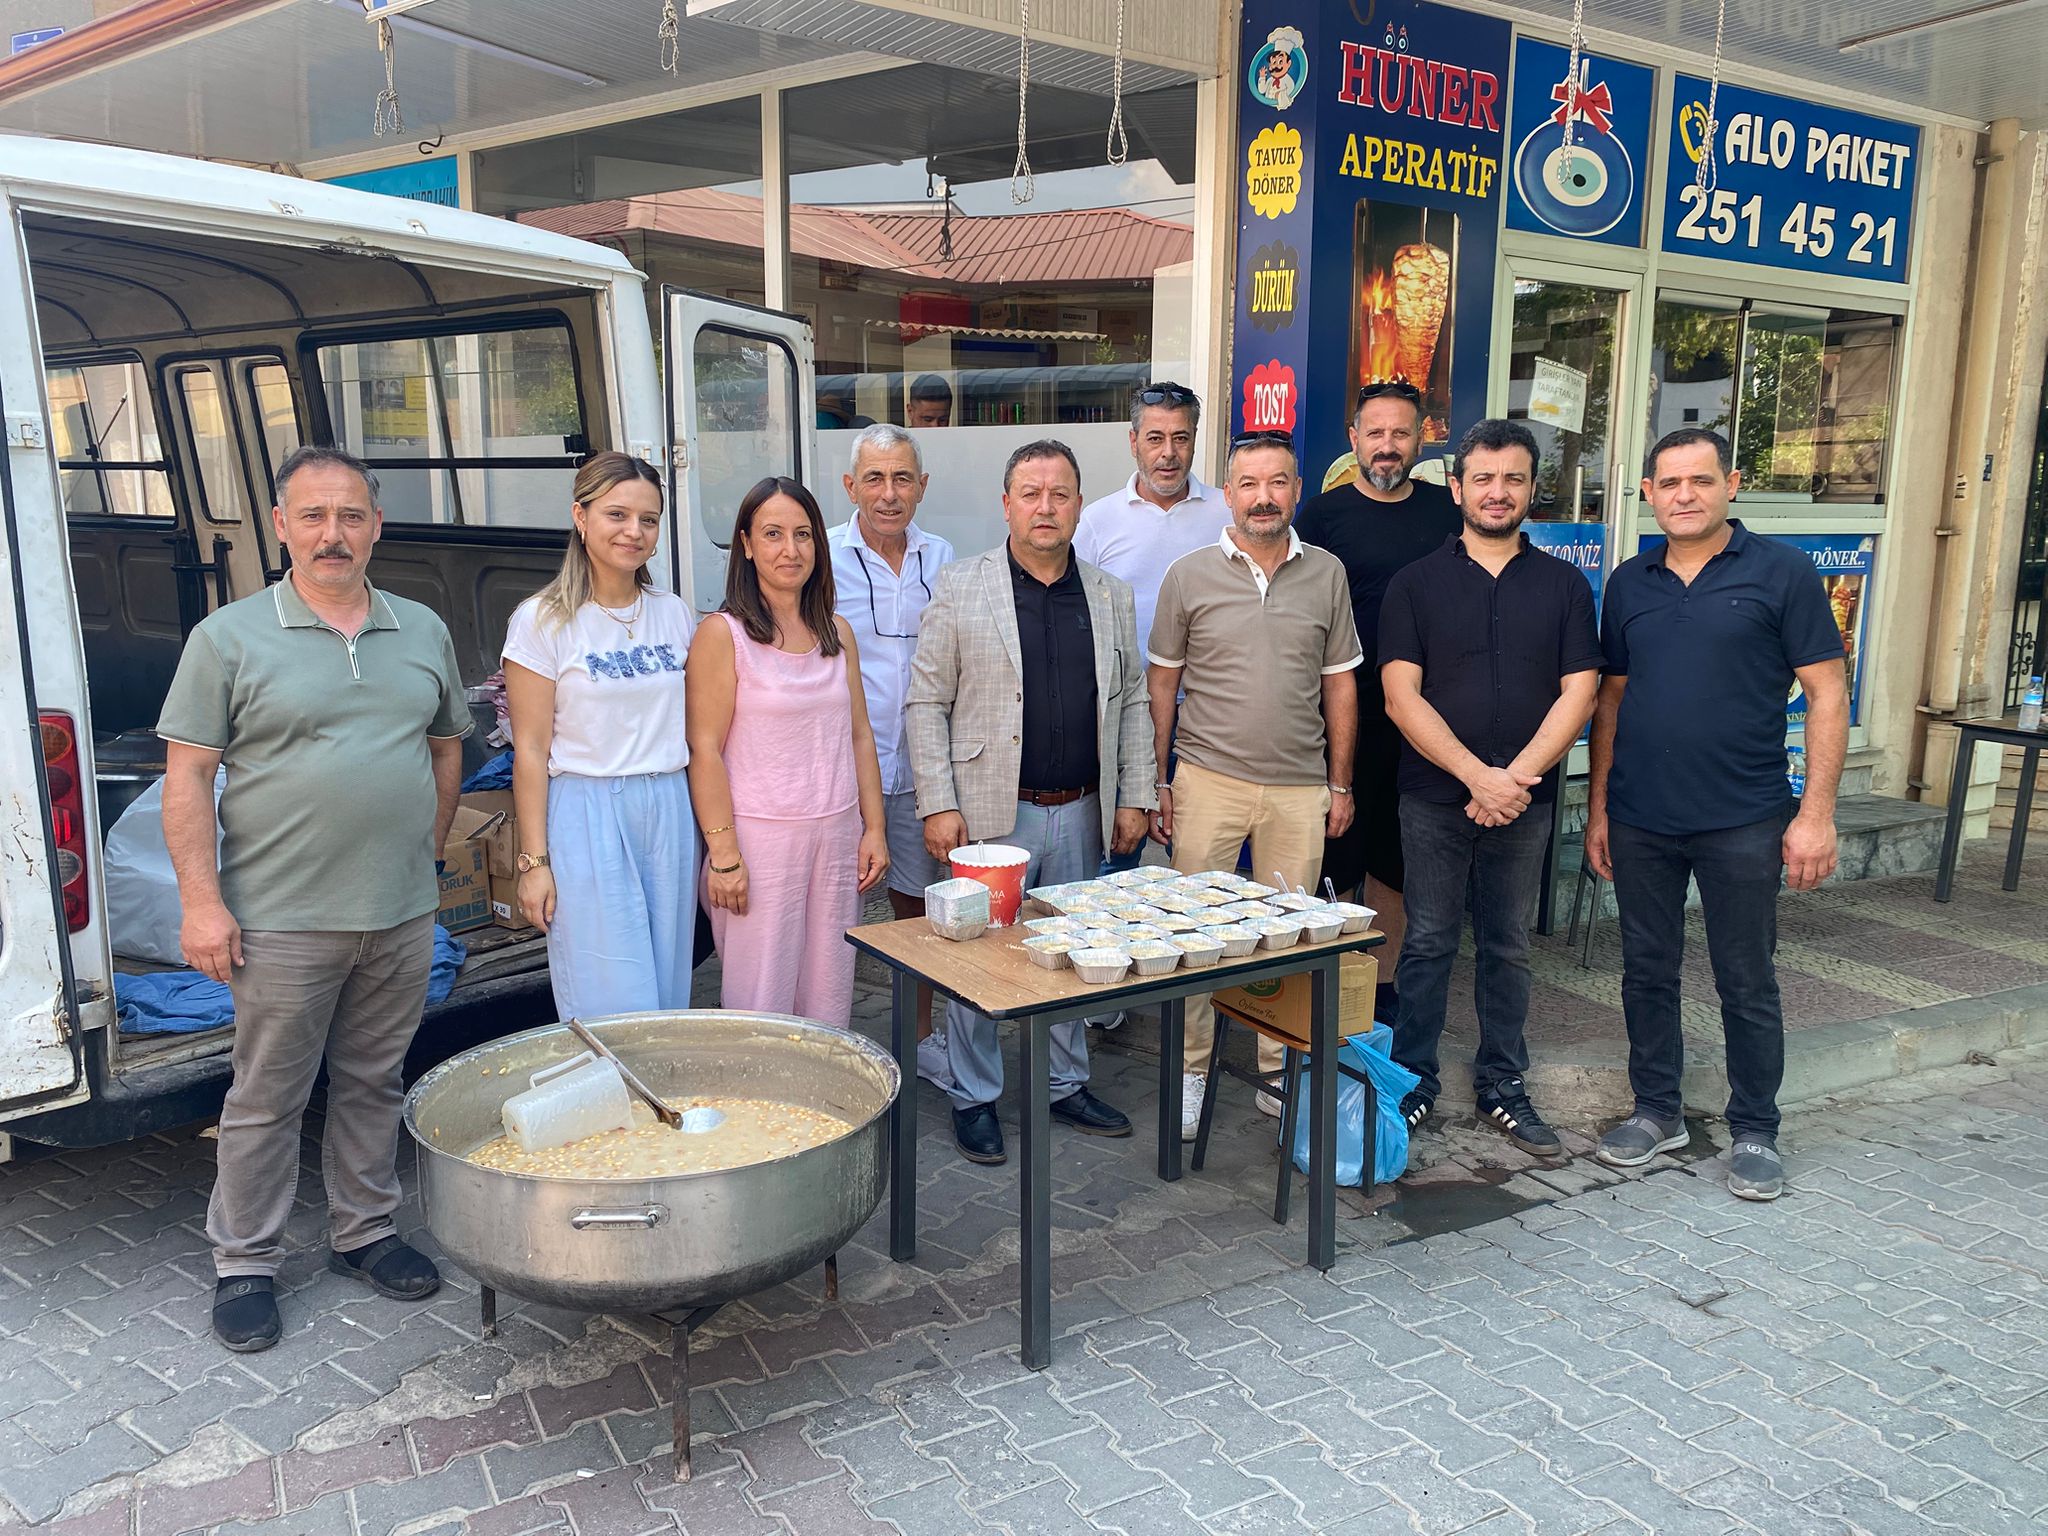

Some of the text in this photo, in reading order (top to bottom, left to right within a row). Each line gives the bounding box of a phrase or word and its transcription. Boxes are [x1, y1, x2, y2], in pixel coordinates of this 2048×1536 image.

[1338, 26, 1500, 133] HÜNER
[1255, 147, 1297, 167] TAVUK
[1338, 133, 1497, 199] APERATİF
[1725, 112, 1911, 190] ALO PAKET
[1252, 173, 1294, 196] DÖNER
[1676, 184, 1897, 266] 251 45 21
[1252, 259, 1295, 313] DÜRÜM
[1253, 382, 1289, 426] TOST
[585, 643, 684, 682] NICE
